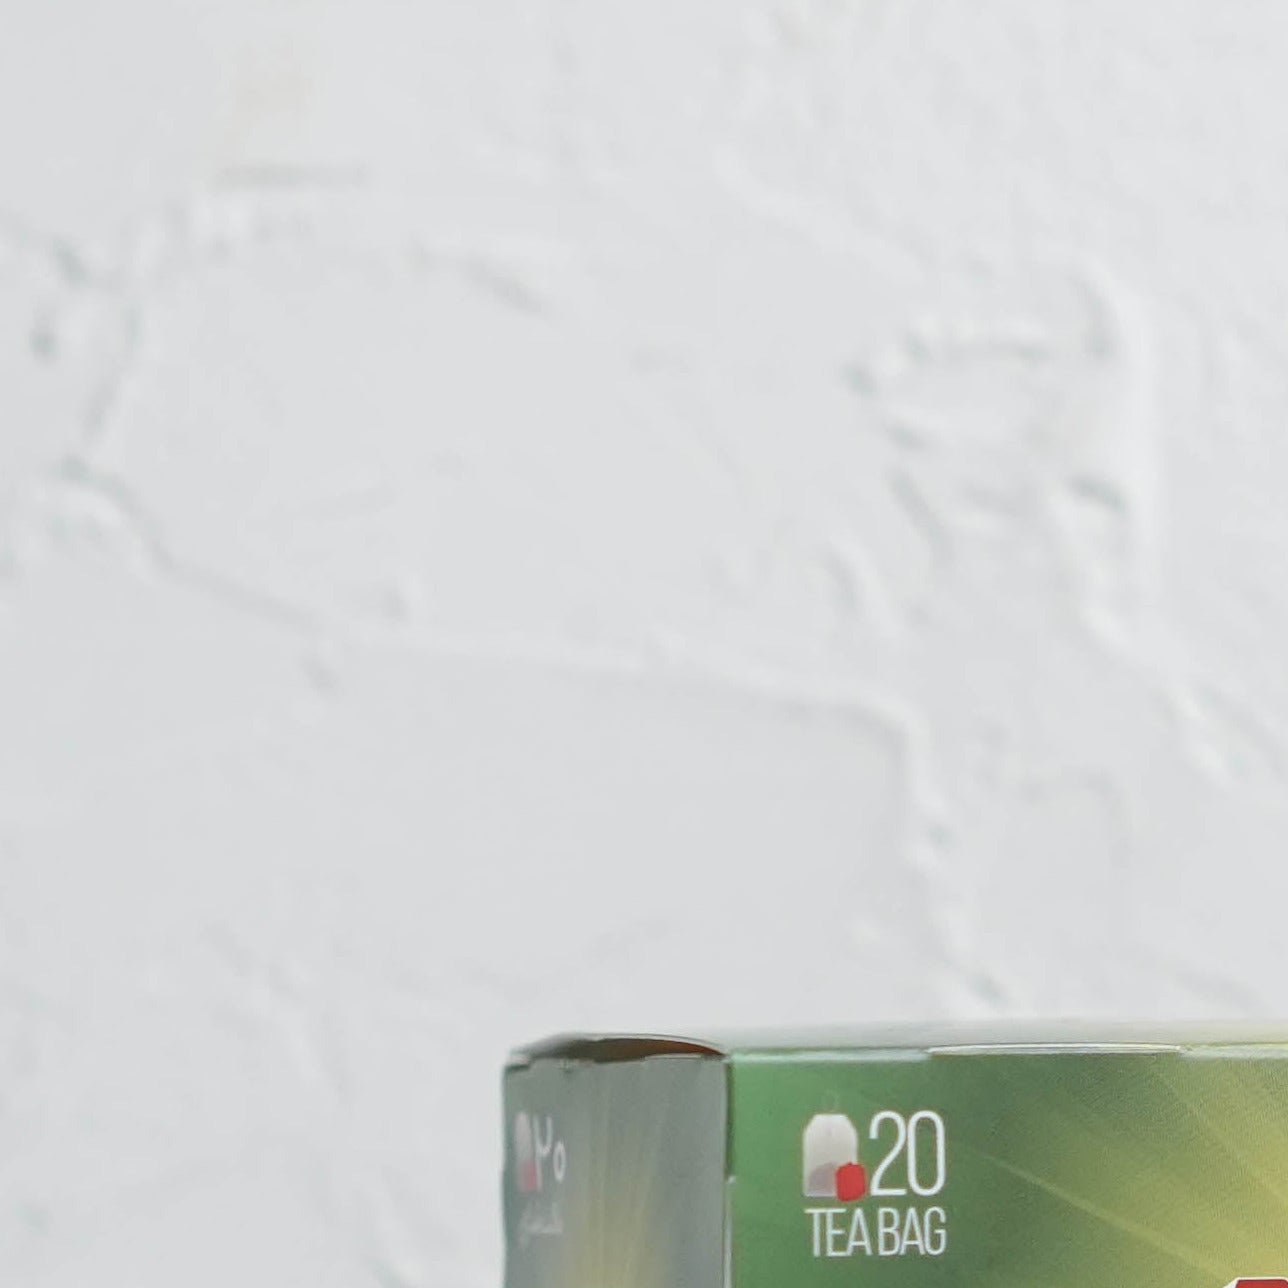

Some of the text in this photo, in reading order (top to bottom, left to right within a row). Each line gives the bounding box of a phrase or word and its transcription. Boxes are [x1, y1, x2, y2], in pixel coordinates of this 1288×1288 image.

[868, 1109, 947, 1197] 20
[803, 1205, 947, 1258] TEA BAG
